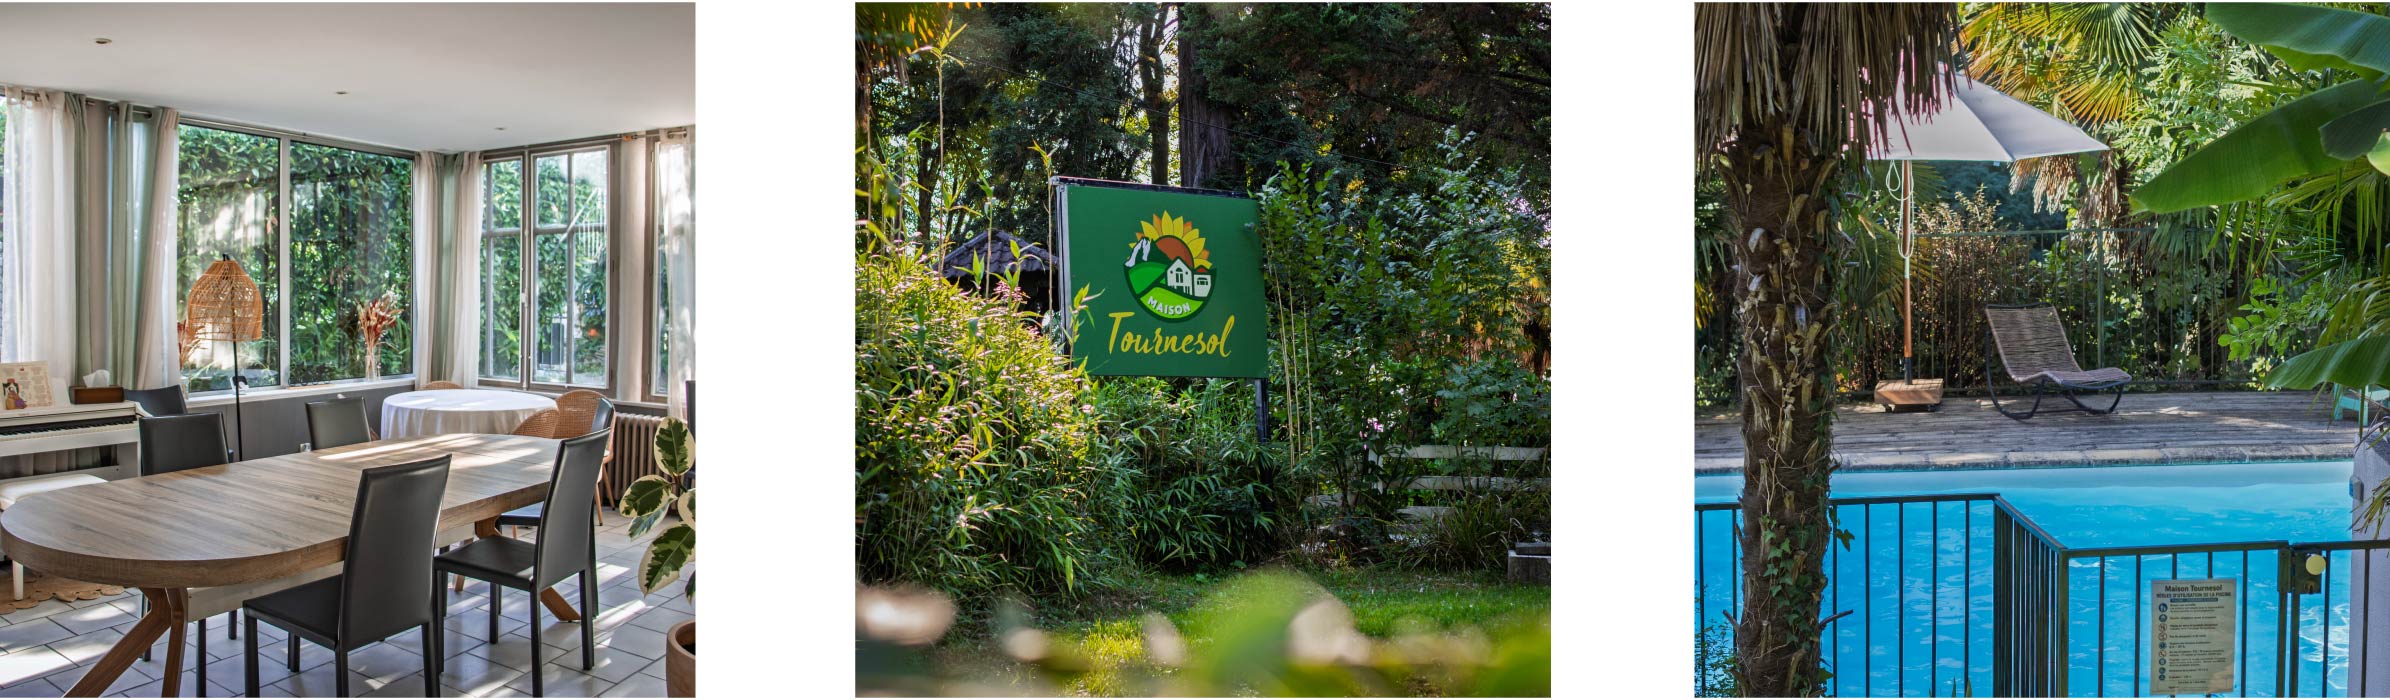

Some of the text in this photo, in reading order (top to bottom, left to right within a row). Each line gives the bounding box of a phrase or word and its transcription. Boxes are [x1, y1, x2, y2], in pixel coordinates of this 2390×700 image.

[1148, 296, 1190, 315] MAISON
[1108, 311, 1235, 357] Tournesol
[2191, 584, 2223, 592] Tournesol
